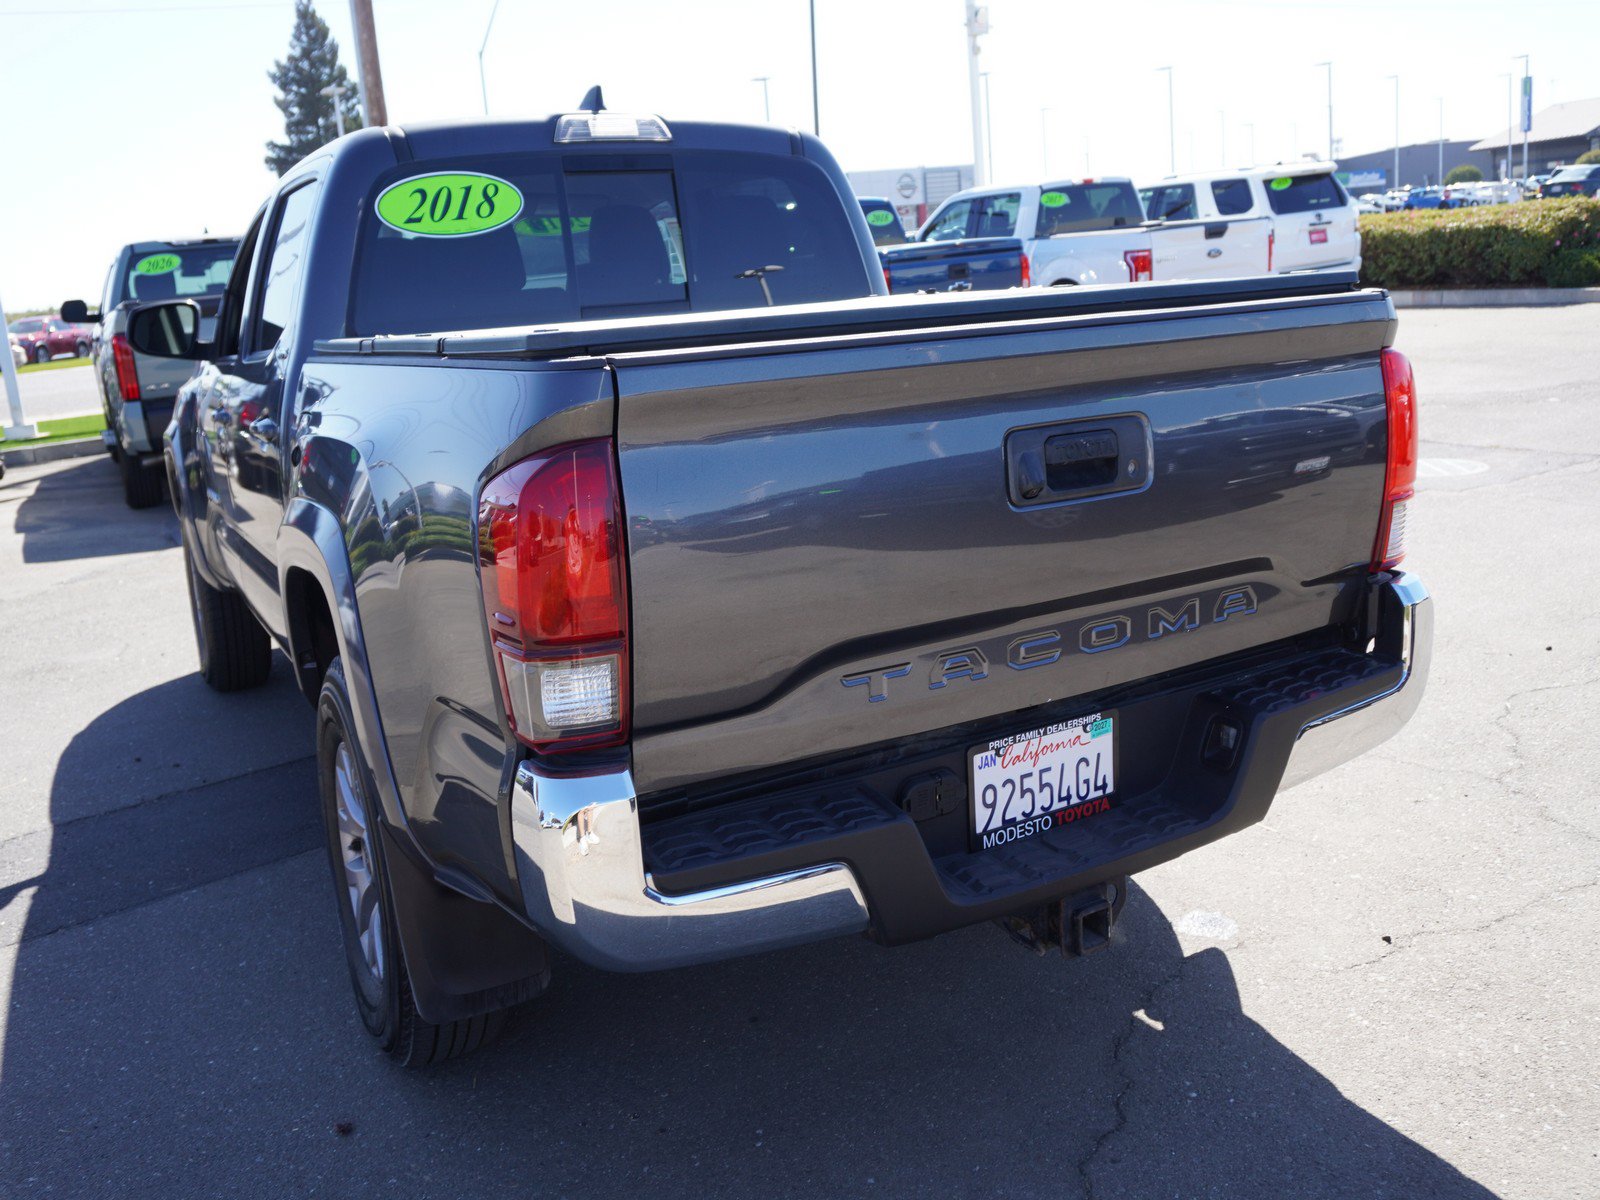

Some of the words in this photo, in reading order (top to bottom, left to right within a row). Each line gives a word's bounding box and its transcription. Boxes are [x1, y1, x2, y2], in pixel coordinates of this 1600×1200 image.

[402, 183, 499, 225] 2018
[145, 257, 172, 273] 2026
[840, 584, 1259, 704] TACOMA
[988, 737, 1014, 751] PRICE
[1015, 727, 1046, 745] FAMILY
[1046, 712, 1102, 735] DEALERSHIPS
[977, 755, 997, 770] JAN
[1001, 734, 1091, 770] California
[981, 752, 1108, 833] 92554G4
[982, 815, 1052, 850] MODESTO
[1055, 797, 1111, 826] TOYOTA
